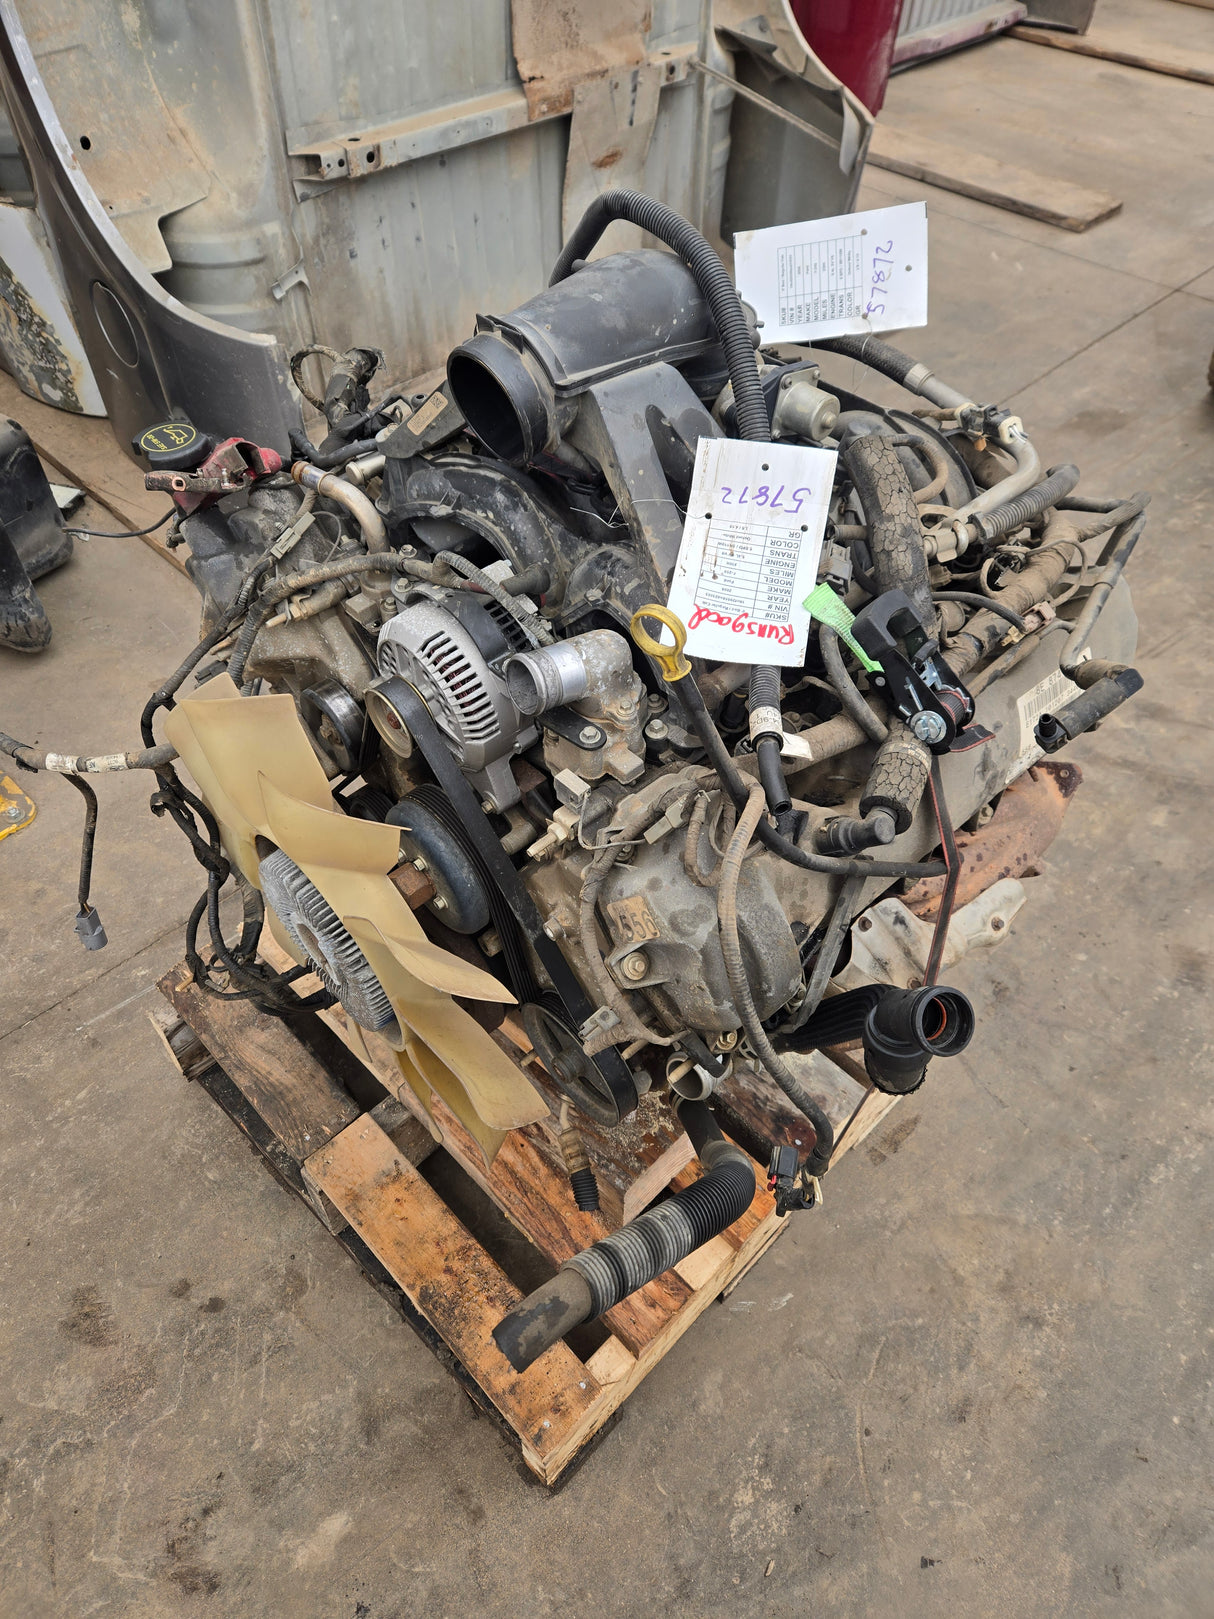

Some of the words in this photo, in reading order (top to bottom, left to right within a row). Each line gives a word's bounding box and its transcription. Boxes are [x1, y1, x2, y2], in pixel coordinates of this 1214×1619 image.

[865, 240, 894, 315] 57872
[855, 305, 861, 315] GR
[720, 485, 811, 514] 57872
[770, 539, 799, 549] COLOR
[769, 550, 797, 559] TRANS
[764, 559, 796, 568] ENGINE
[769, 569, 794, 578] MILES
[764, 577, 793, 586] MODEL
[767, 586, 792, 595] MAKE
[767, 595, 789, 603] YEAR
[765, 612, 787, 620] SKU#
[619, 911, 658, 941] 556
